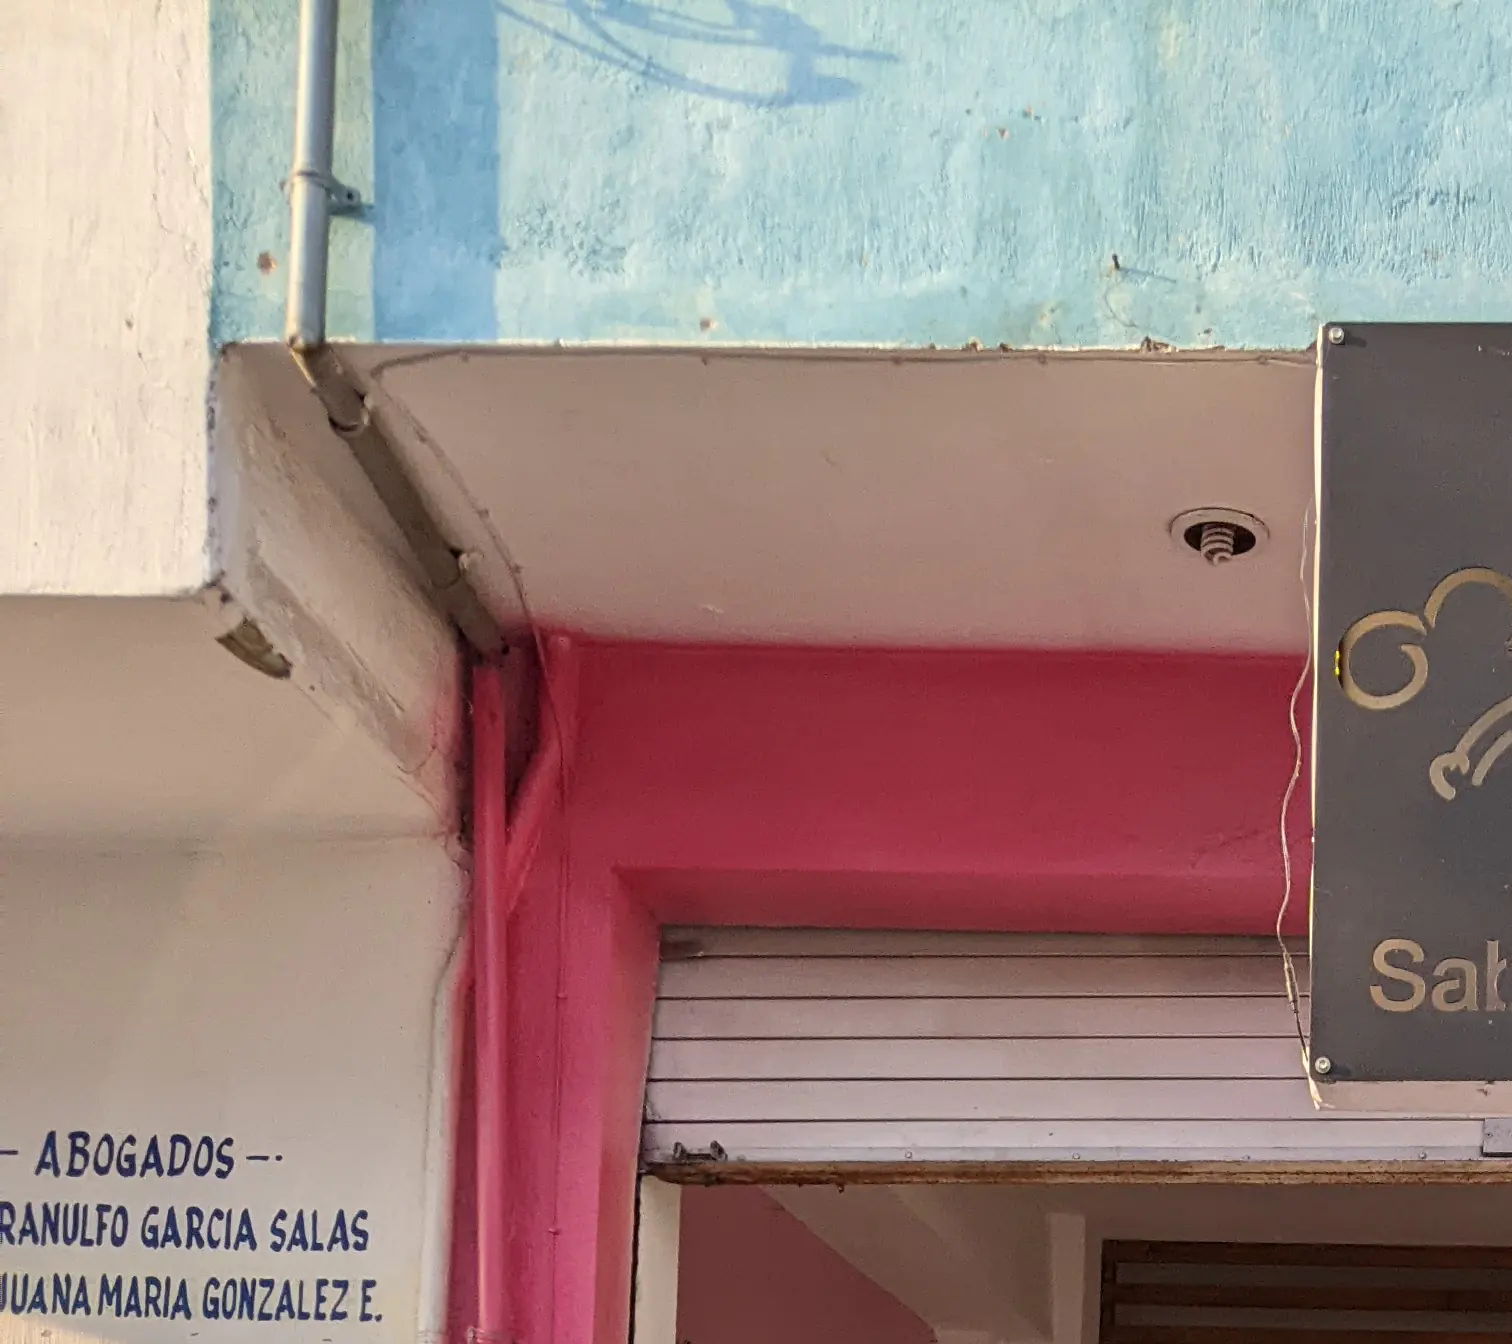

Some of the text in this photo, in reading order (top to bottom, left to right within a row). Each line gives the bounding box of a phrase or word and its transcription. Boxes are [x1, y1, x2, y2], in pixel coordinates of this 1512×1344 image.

[34, 1129, 236, 1180] ABOGADOS
[0, 1201, 370, 1252] RANULFO GARCIA SALAS
[97, 1273, 192, 1320] MARIA
[202, 1277, 350, 1321] GONZALEZ
[359, 1279, 384, 1323] E.
